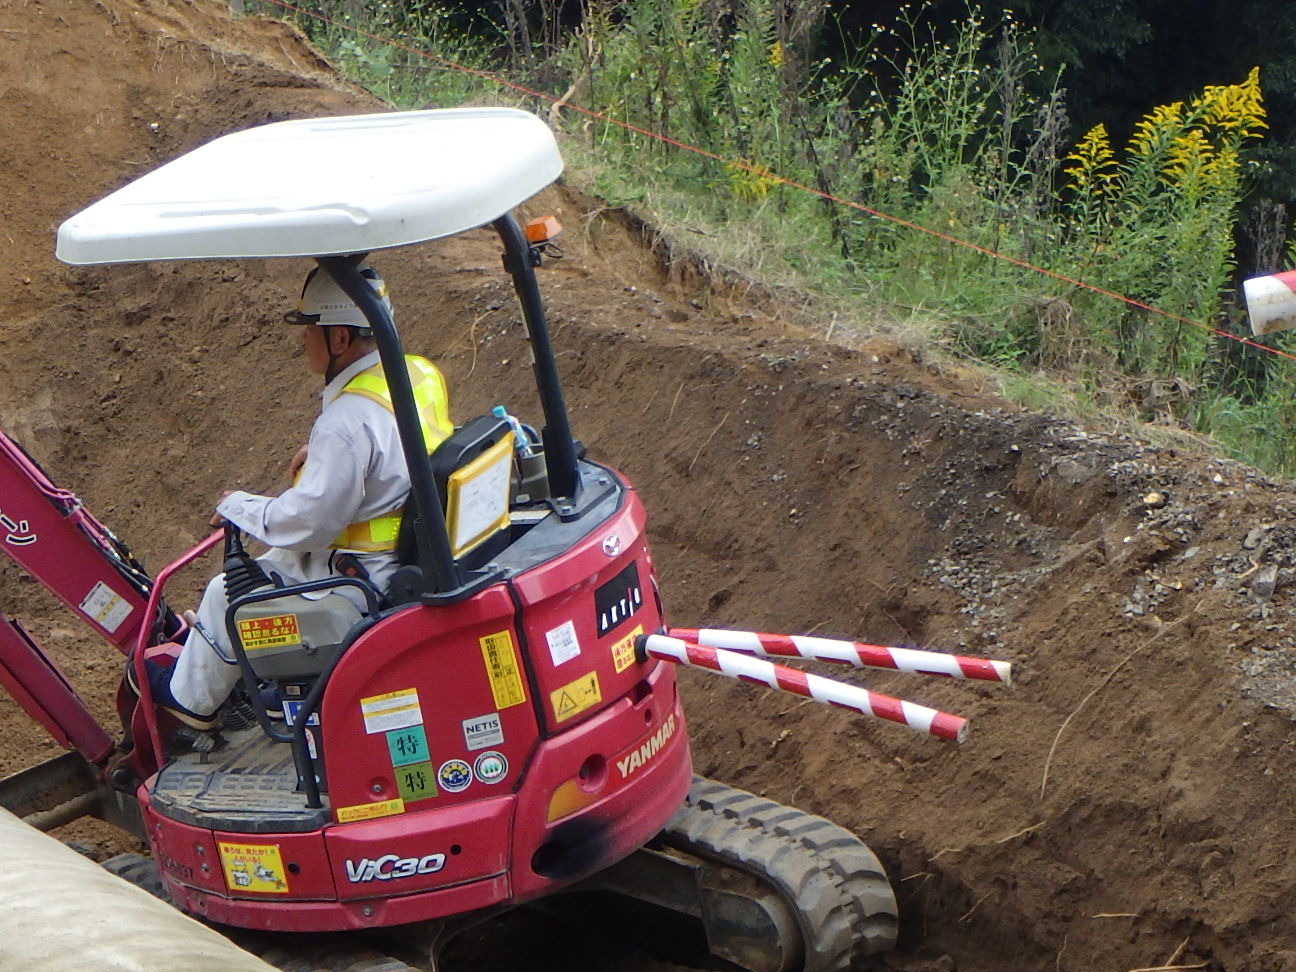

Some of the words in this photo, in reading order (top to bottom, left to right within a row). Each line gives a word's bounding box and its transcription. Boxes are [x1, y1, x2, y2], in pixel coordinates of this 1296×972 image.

[601, 587, 641, 631] AKTIO
[466, 719, 499, 734] NETIS
[396, 734, 419, 756] 特
[616, 713, 675, 779] YANMAR
[405, 771, 427, 793] 特
